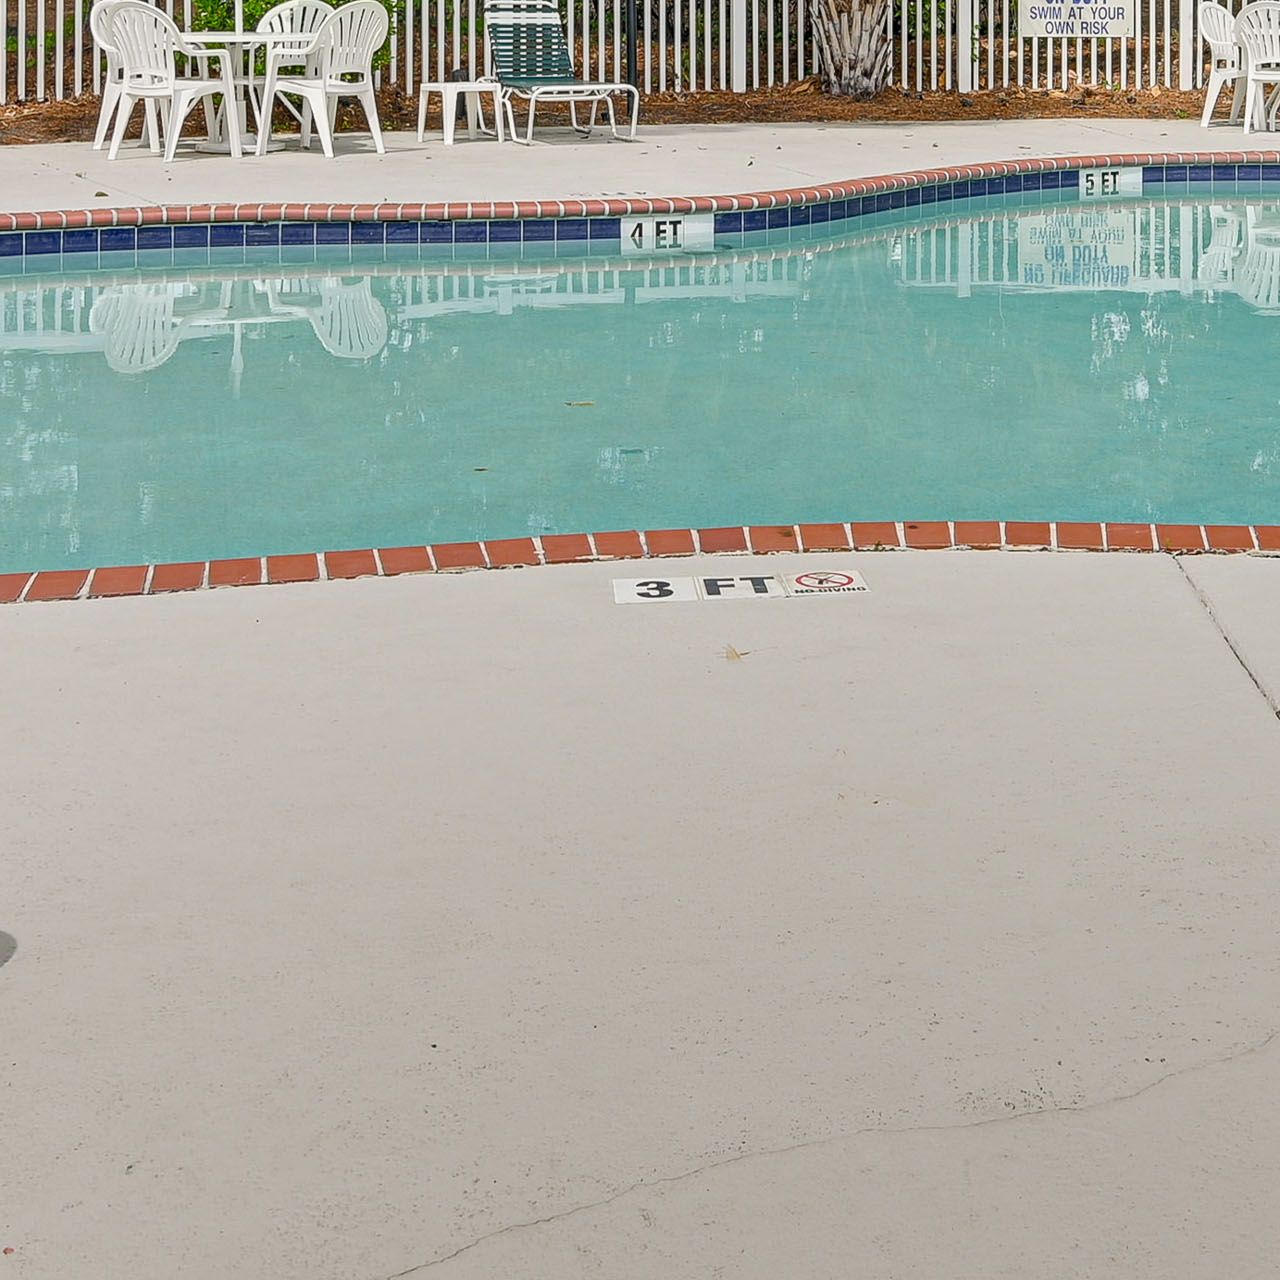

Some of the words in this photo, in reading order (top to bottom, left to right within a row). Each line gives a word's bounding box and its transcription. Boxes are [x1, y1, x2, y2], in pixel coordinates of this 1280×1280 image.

[1030, 6, 1062, 20] SWIM
[1068, 6, 1084, 20] AT
[1090, 6, 1125, 20] YOUR
[1045, 21, 1074, 34] OWN
[1080, 21, 1109, 34] RISK
[635, 580, 674, 598] 3
[703, 576, 774, 596] FT
